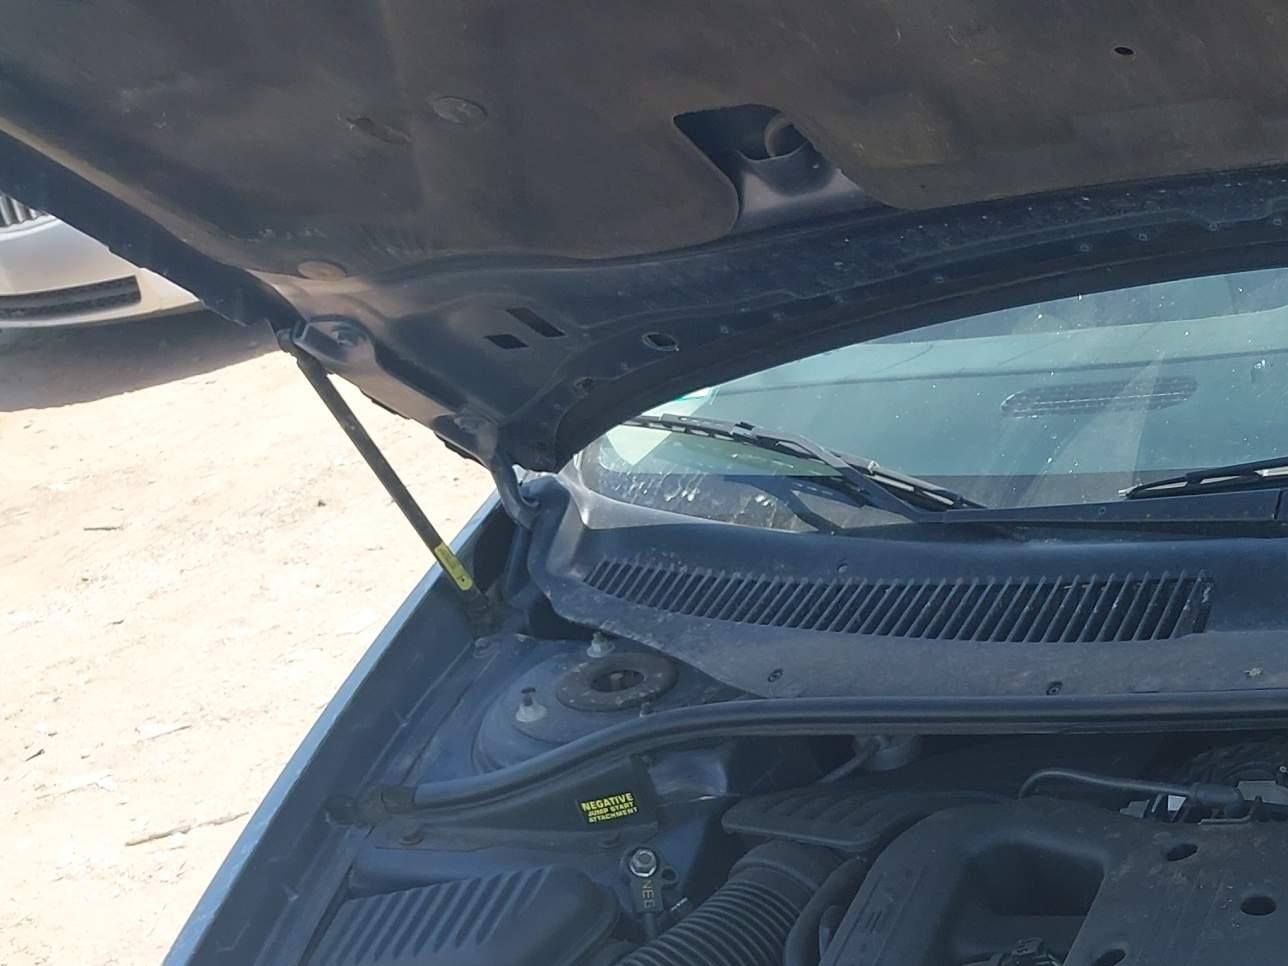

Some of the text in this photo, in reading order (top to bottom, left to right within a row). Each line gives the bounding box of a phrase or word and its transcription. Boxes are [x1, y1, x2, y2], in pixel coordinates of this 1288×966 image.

[581, 793, 634, 811] NEGATIVE
[588, 802, 634, 816] JUMP START
[588, 807, 638, 823] ATTACHMENT
[642, 880, 655, 909] NEG
